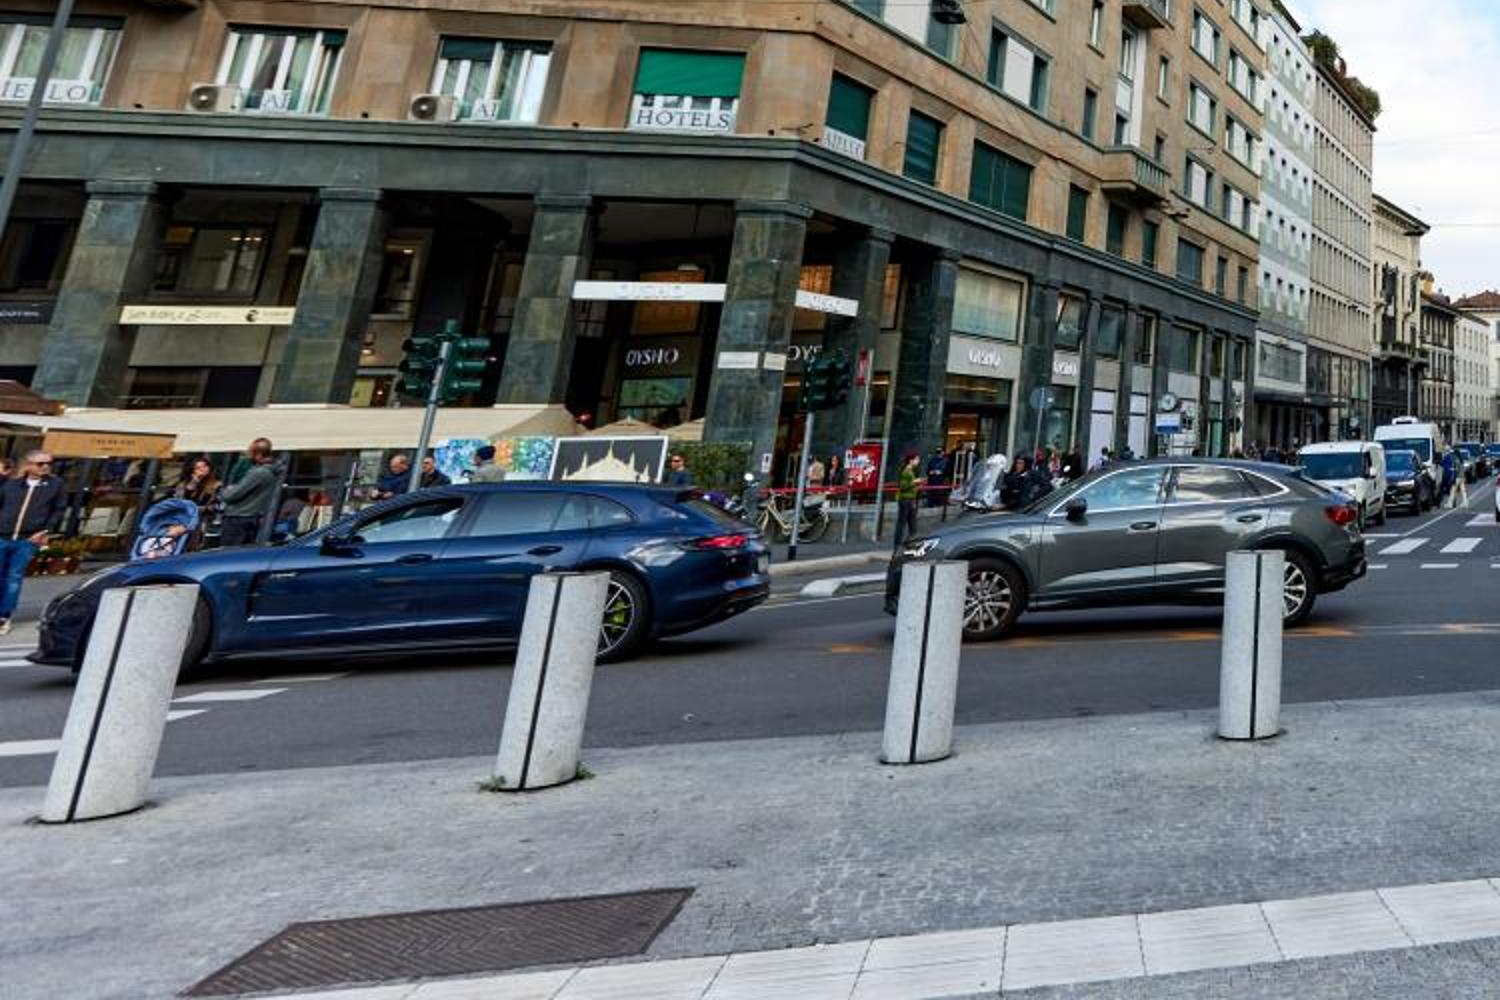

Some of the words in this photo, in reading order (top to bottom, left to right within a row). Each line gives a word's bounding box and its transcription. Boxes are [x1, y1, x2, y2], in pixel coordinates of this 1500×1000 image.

[2, 80, 87, 101] IELO
[637, 109, 731, 129] HOTELS
[625, 347, 679, 367] OYSHO
